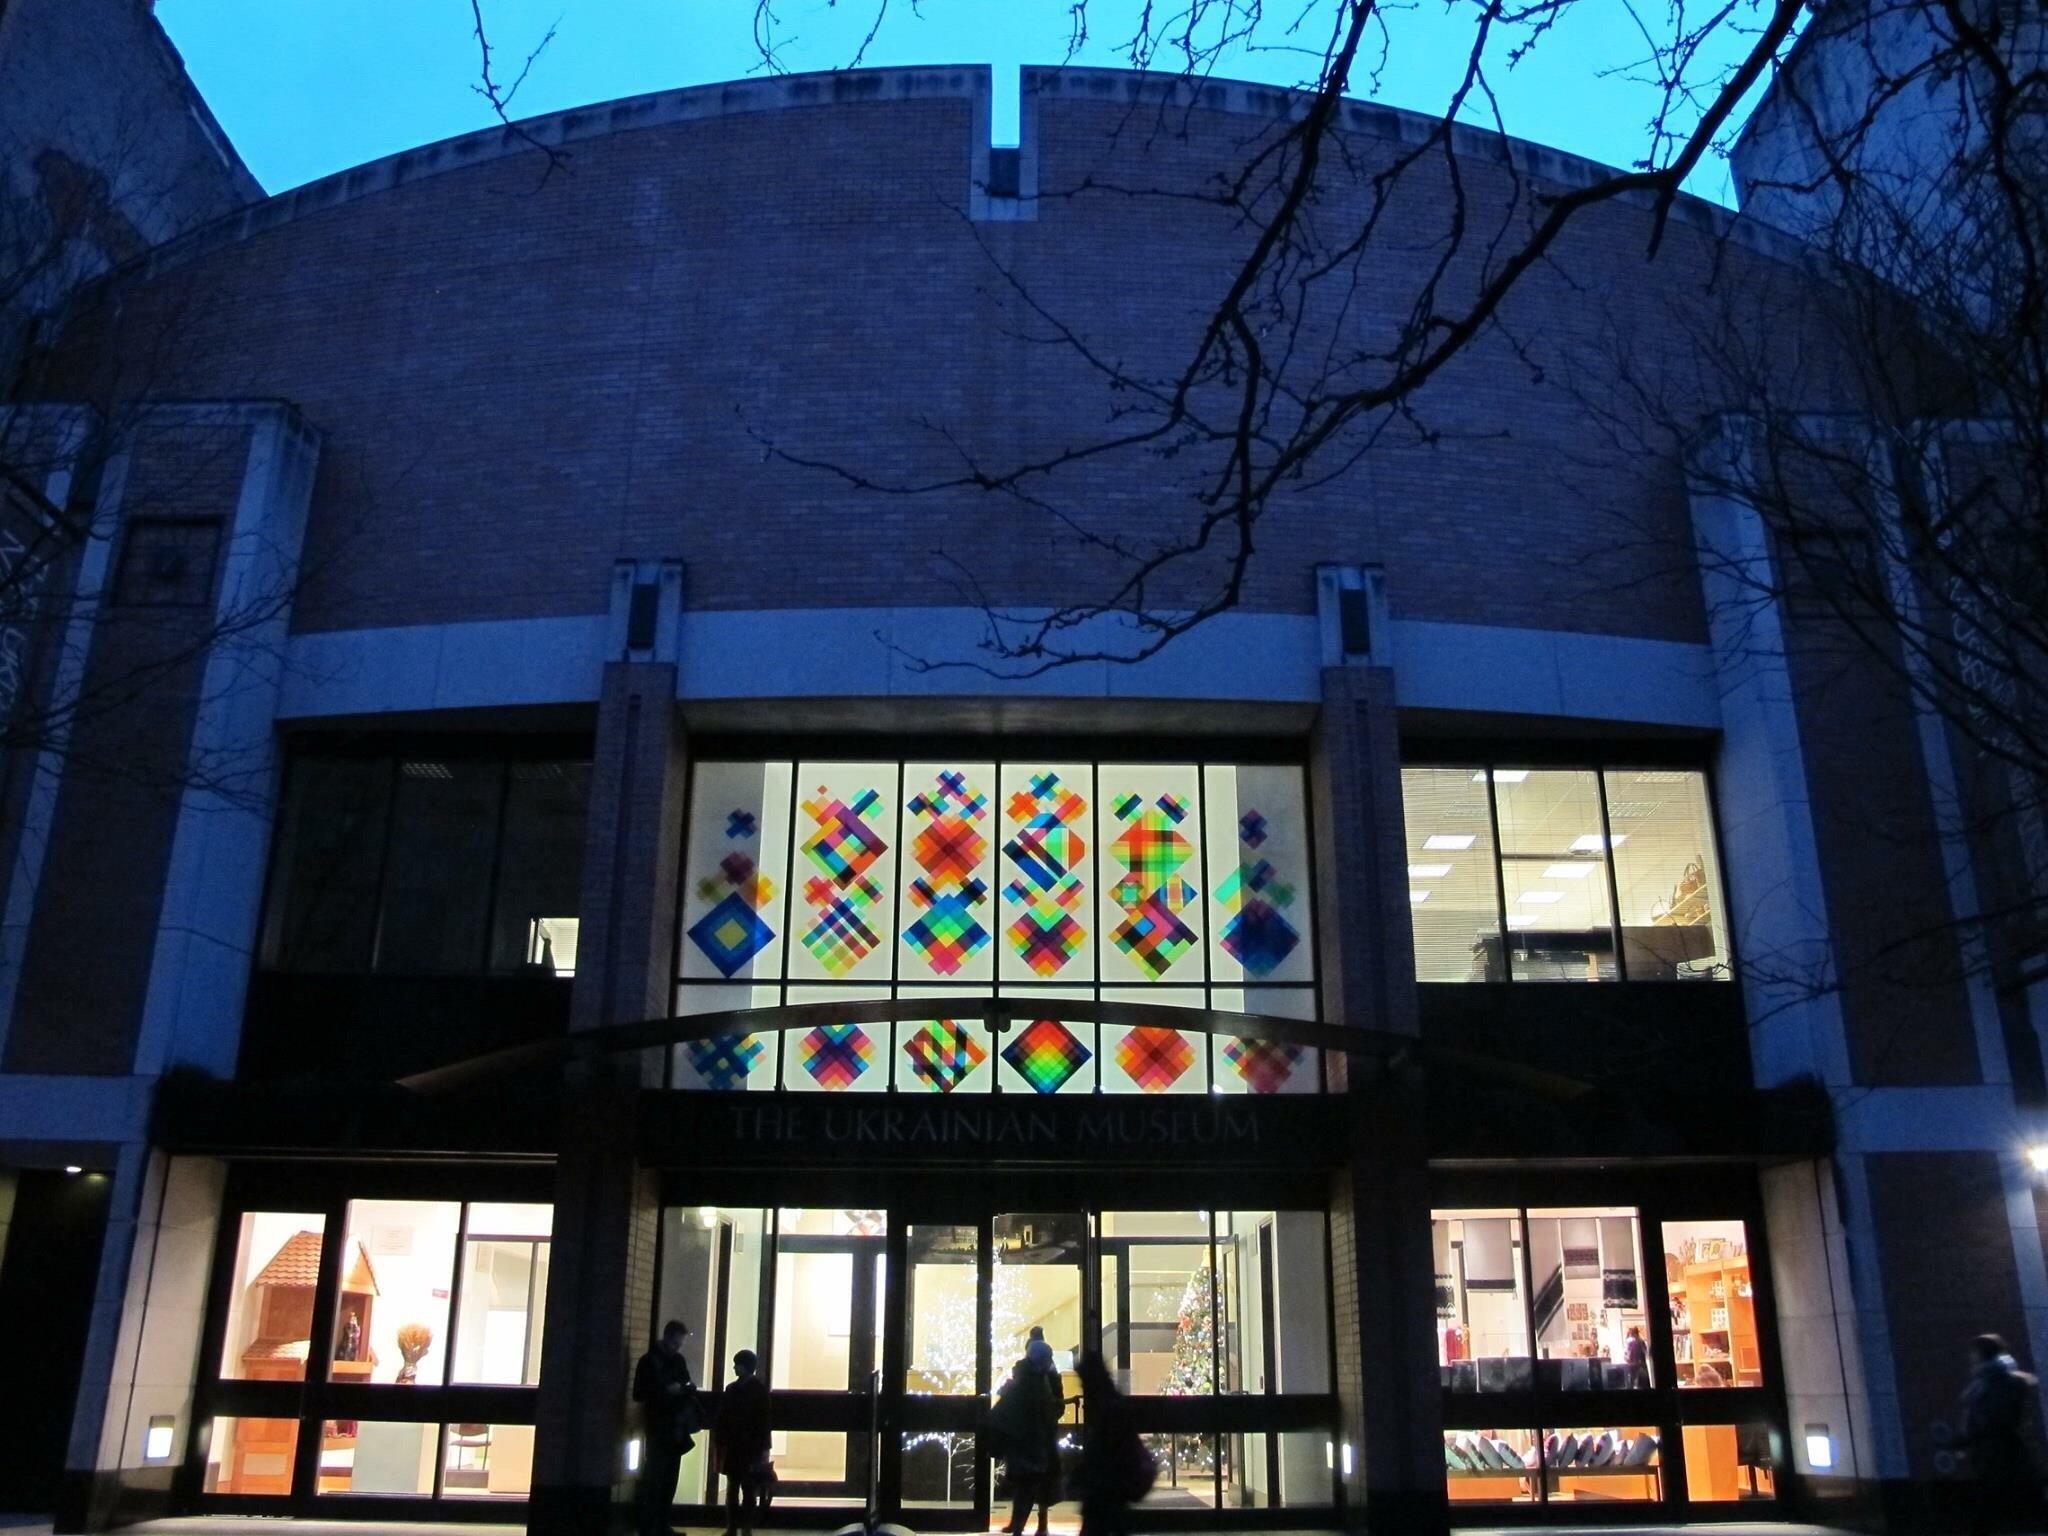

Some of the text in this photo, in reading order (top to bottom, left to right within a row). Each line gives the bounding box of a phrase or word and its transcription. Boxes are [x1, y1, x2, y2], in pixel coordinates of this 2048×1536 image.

[730, 1106, 1260, 1143] THE UKRAINIAN MUSEUM
